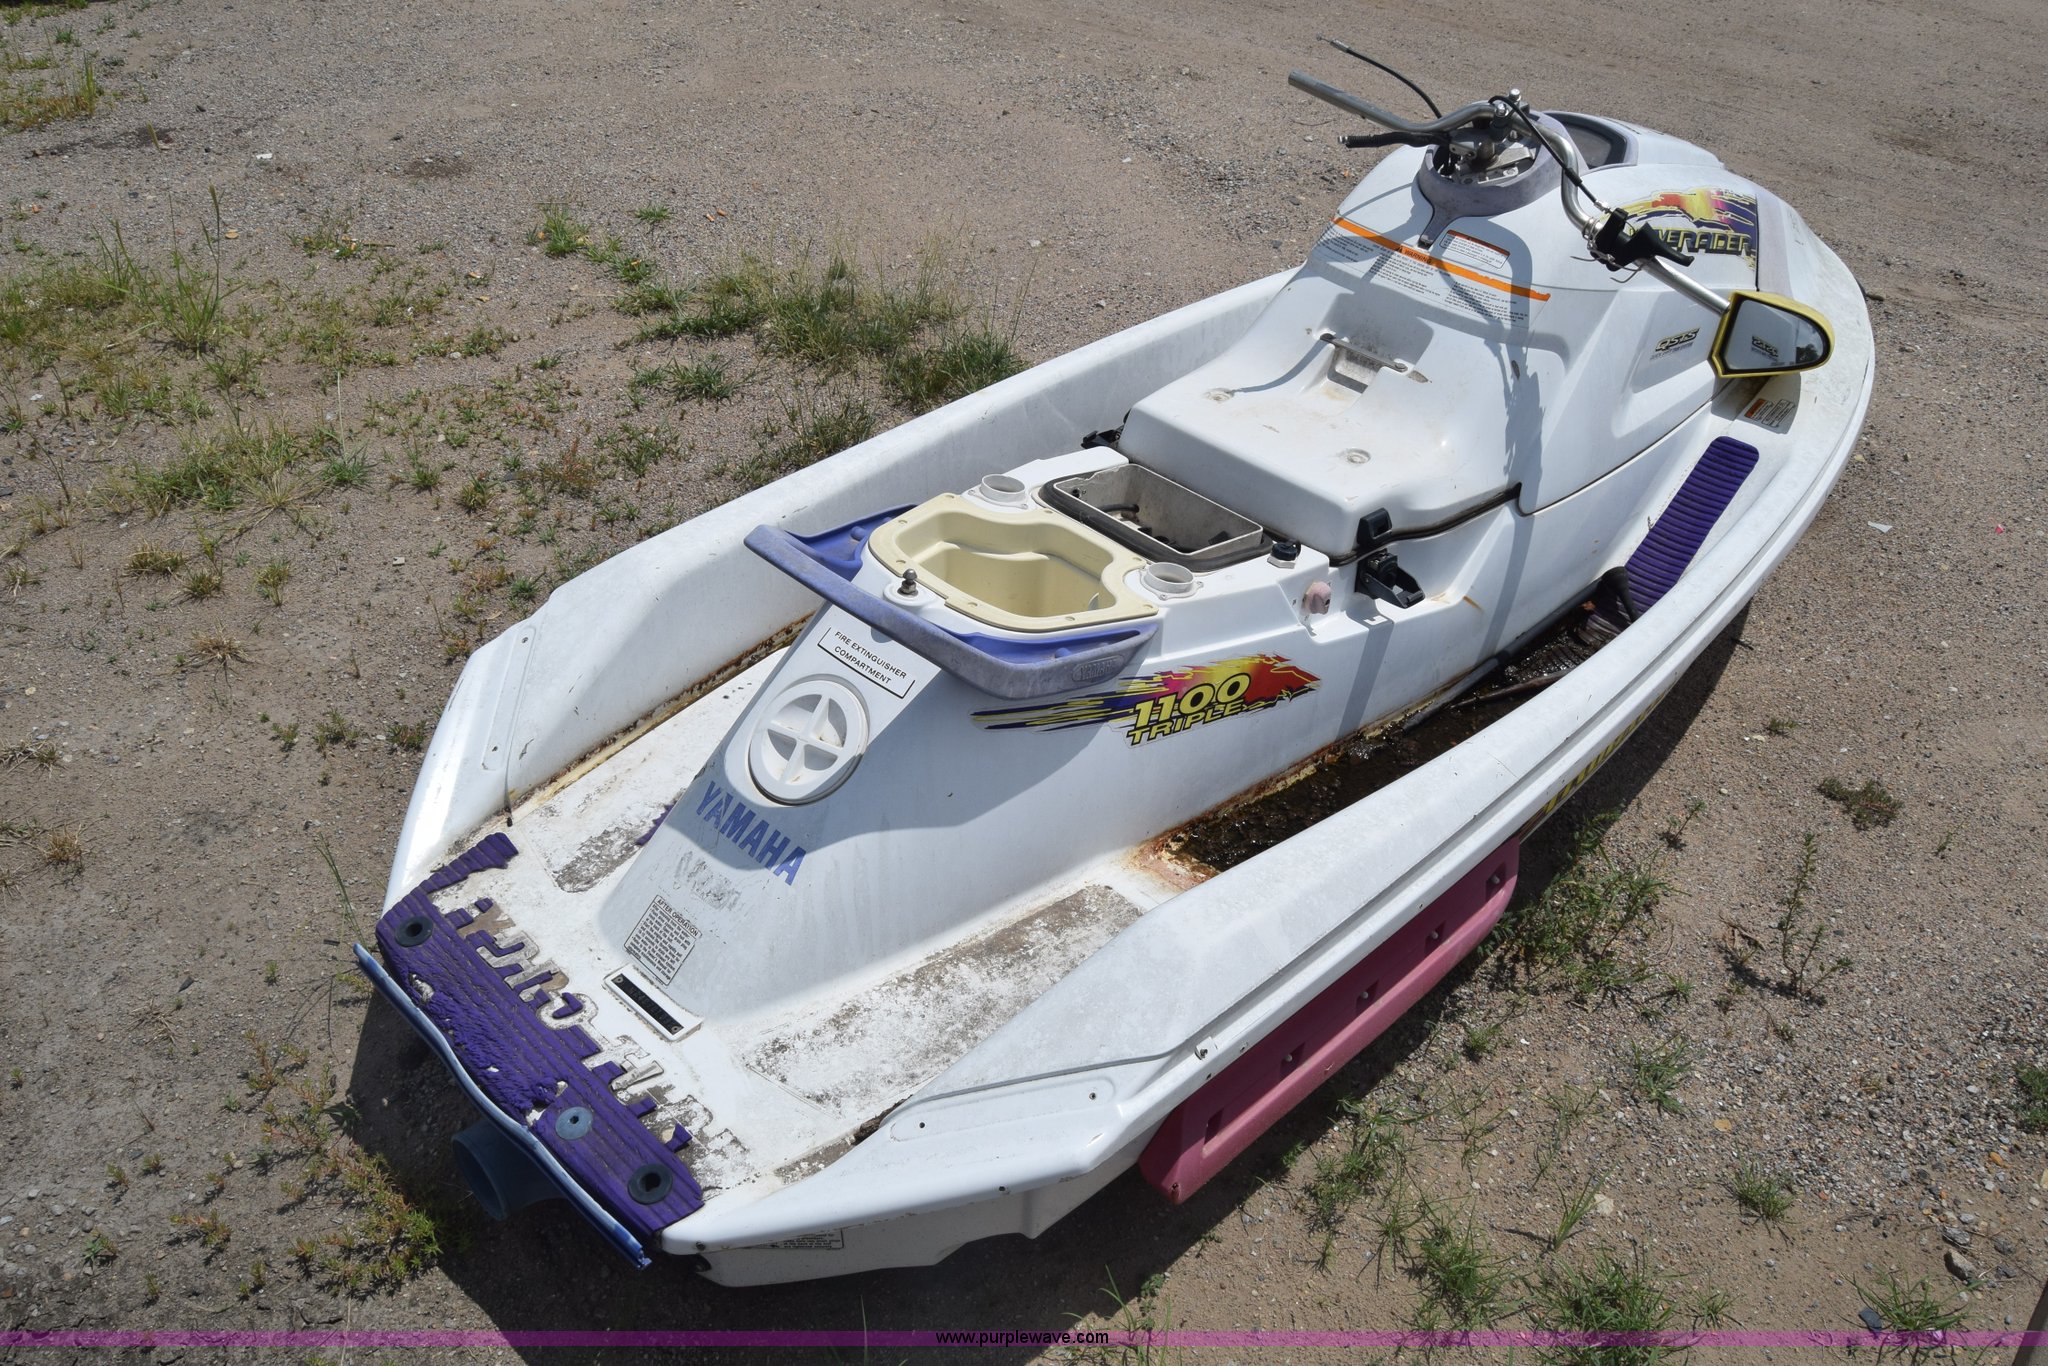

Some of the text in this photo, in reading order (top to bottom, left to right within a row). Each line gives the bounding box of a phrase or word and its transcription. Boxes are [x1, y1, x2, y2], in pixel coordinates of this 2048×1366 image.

[834, 645, 892, 684] COMPARTMENT
[835, 631, 907, 680] FIRE EXTINGUISHER
[1127, 699, 1243, 745] TRIPLE
[1133, 672, 1251, 730] 1100
[696, 781, 806, 886] YAMAHA
[657, 899, 699, 937] AFTER OPERATION
